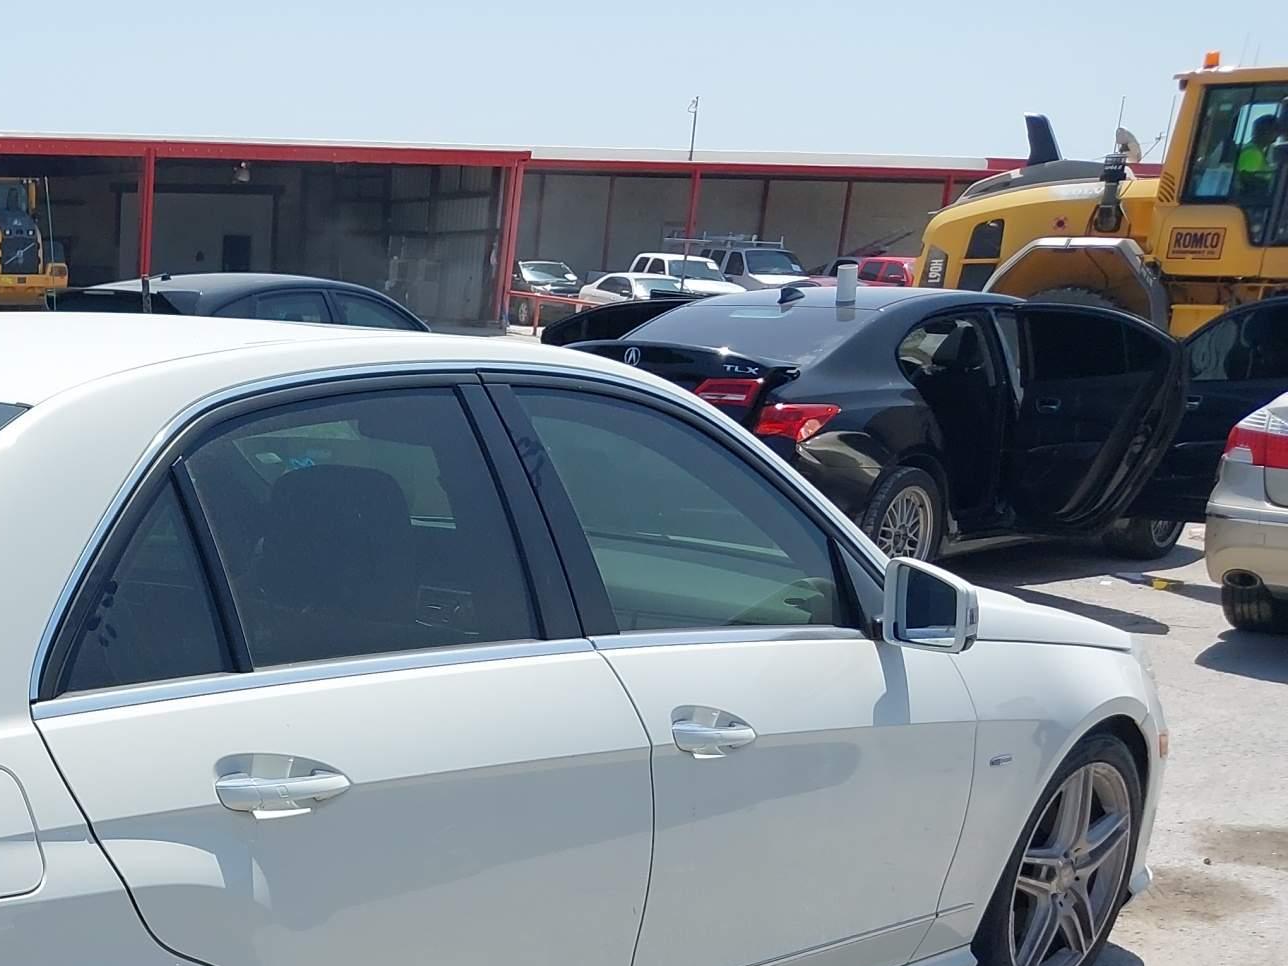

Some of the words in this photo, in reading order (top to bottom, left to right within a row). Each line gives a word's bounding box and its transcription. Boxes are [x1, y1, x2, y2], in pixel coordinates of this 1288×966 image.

[1173, 231, 1220, 249] ROMCO
[928, 259, 944, 283] L90H
[723, 364, 759, 375] TLX
